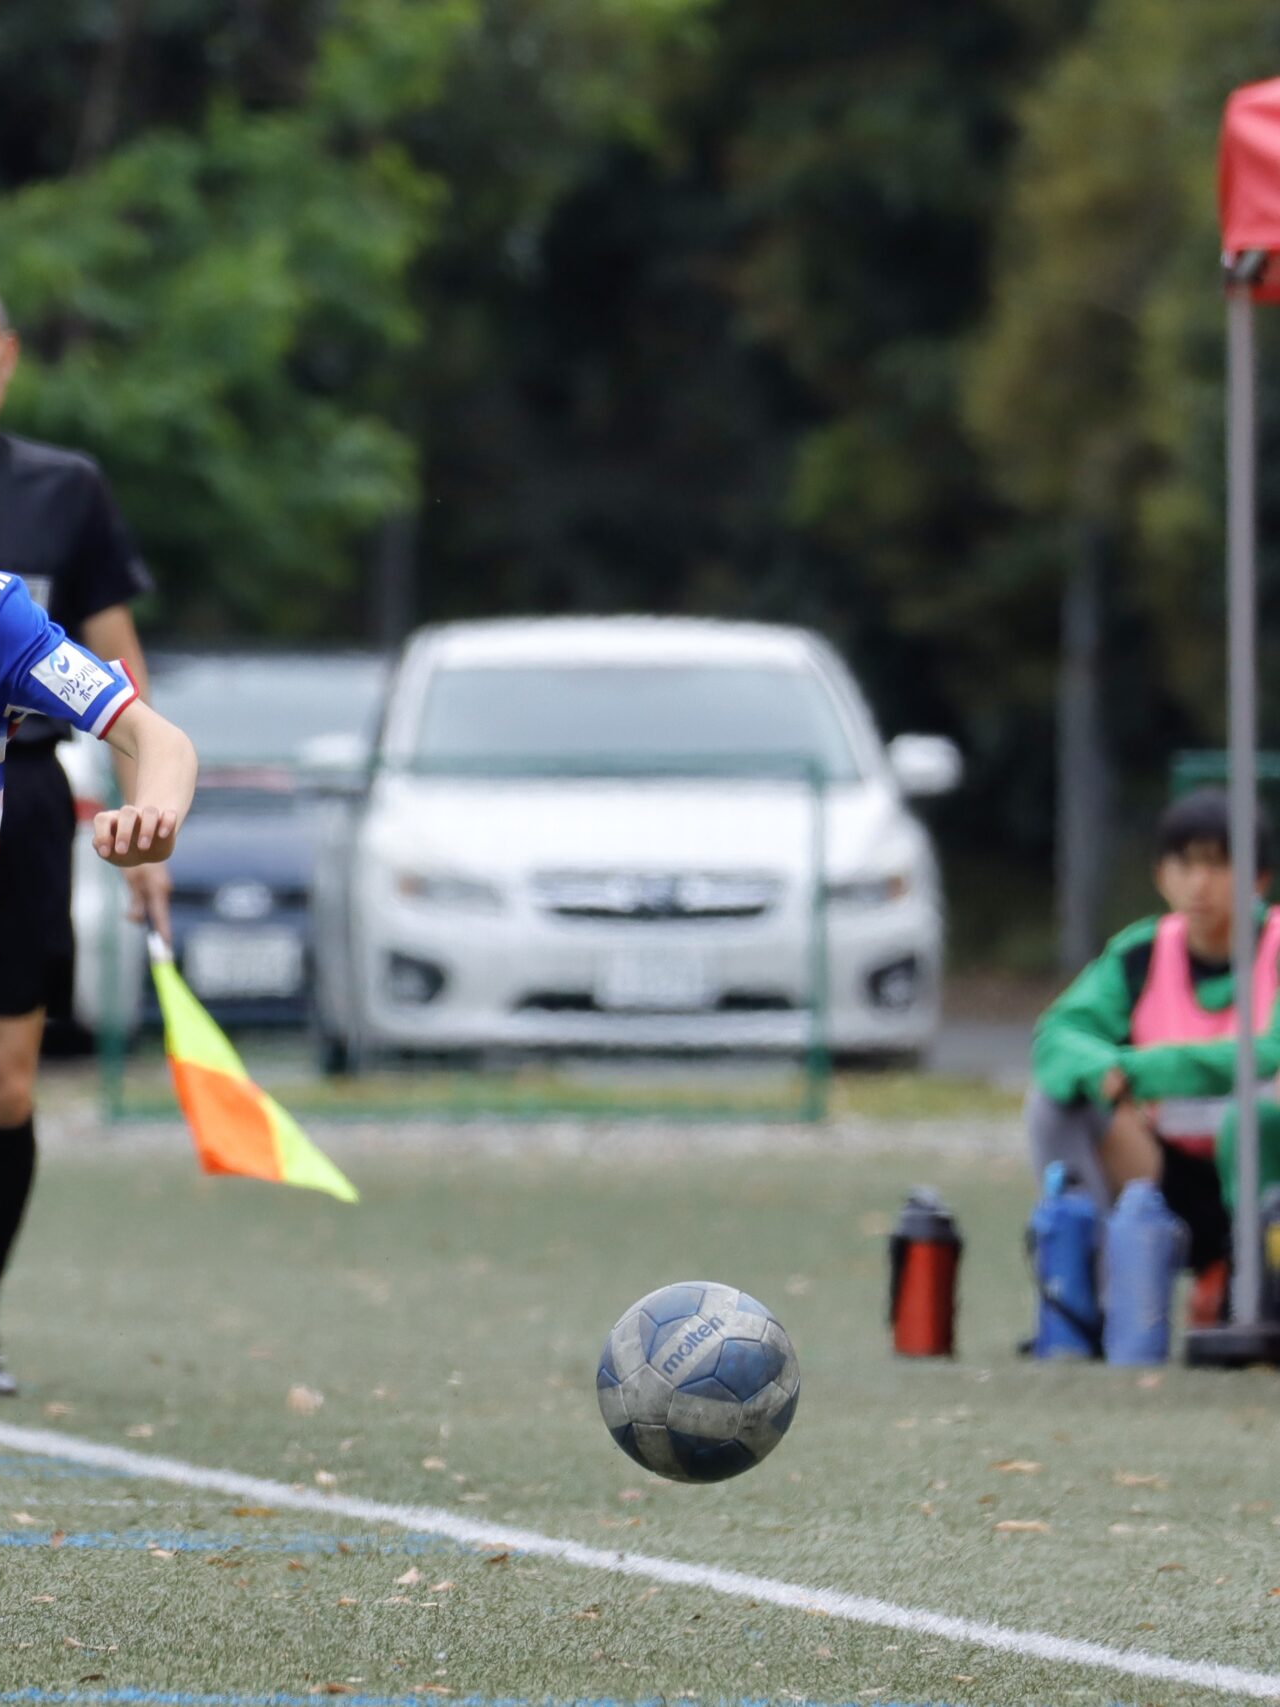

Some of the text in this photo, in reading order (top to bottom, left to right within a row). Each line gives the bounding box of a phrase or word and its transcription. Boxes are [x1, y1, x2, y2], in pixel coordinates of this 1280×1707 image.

[80, 678, 104, 702] ホーム
[663, 1314, 725, 1376] molten
